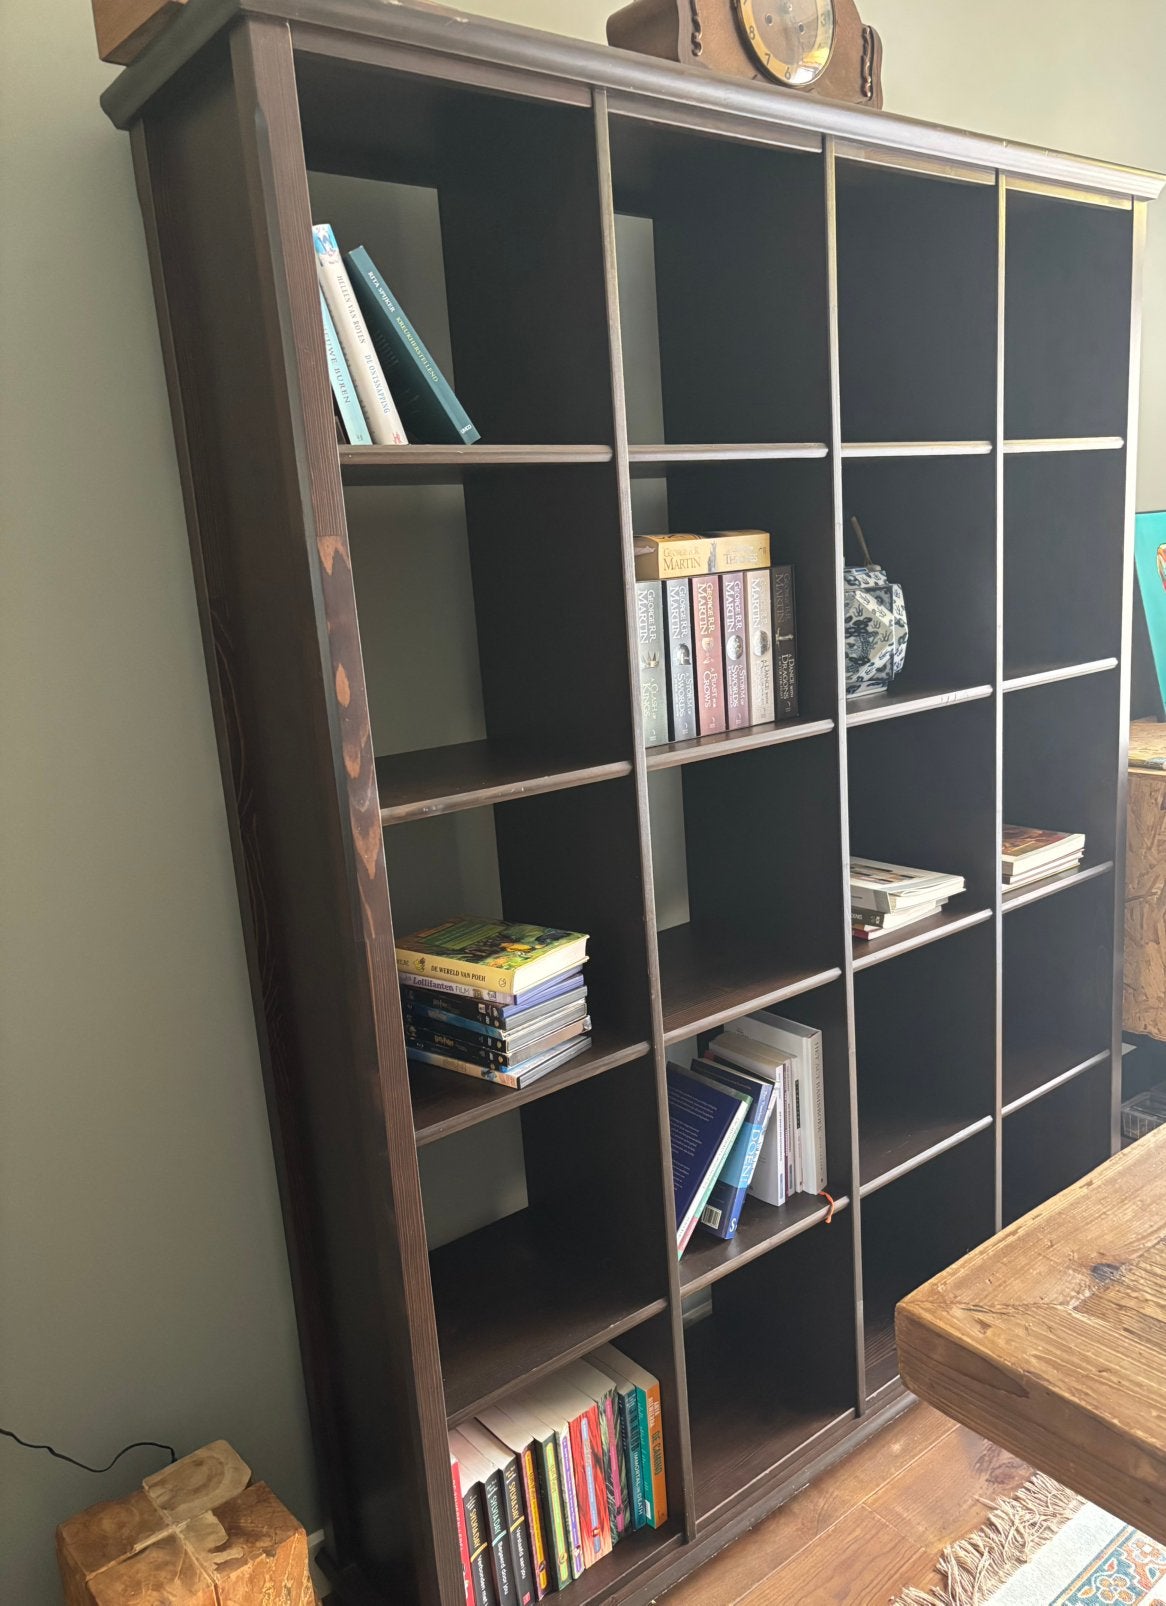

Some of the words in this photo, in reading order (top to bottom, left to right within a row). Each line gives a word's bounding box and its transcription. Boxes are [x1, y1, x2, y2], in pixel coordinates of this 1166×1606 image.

[748, 25, 756, 40] 8
[764, 52, 771, 66] 7
[784, 66, 792, 81] 6
[337, 275, 351, 303] HELEEN
[347, 302, 357, 319] VAN
[367, 271, 381, 288] RITA
[376, 286, 397, 313] SPIJKER
[364, 353, 373, 364] DE
[395, 316, 440, 383] KREUKHERSTELLEND
[334, 367, 351, 405] BUREN
[368, 364, 391, 414] ONTSNAPPING
[663, 557, 701, 571] MARTIN
[647, 589, 656, 624] GEORGE
[669, 586, 681, 639] MARTIN
[679, 585, 687, 620] GEORGE
[697, 583, 708, 635] MARTIN
[706, 582, 714, 617] GEORGE
[726, 581, 735, 632] MARTIN
[751, 577, 760, 628] MARTIN
[775, 573, 785, 623] MARTIN
[638, 589, 649, 644] MARTIN
[703, 670, 712, 708] CROWS
[731, 664, 739, 708] SWORDS
[781, 653, 789, 700] DRAGONS
[788, 658, 796, 685] DANCE
[642, 682, 651, 718] KINGS
[651, 682, 659, 711] CLASH
[677, 673, 686, 717] SWORDS
[685, 678, 693, 707] STORM
[412, 975, 455, 992] Lollifanten
[454, 984, 471, 995] FILM
[431, 964, 438, 972] DE
[438, 966, 460, 977] WERELD
[460, 971, 471, 979] VAN
[471, 973, 486, 982] POEH
[634, 1451, 643, 1487] IMMORTAL
[490, 1495, 500, 1519] SYLVIA
[508, 1481, 518, 1507] SYLVIA
[636, 1492, 644, 1516] DEATH
[469, 1508, 479, 1535] SYLVIA
[493, 1517, 502, 1534] DAY
[512, 1505, 520, 1521] DAY
[473, 1533, 481, 1549] DAY
[497, 1540, 506, 1569] Begeerd
[477, 1554, 486, 1591] Verbonden
